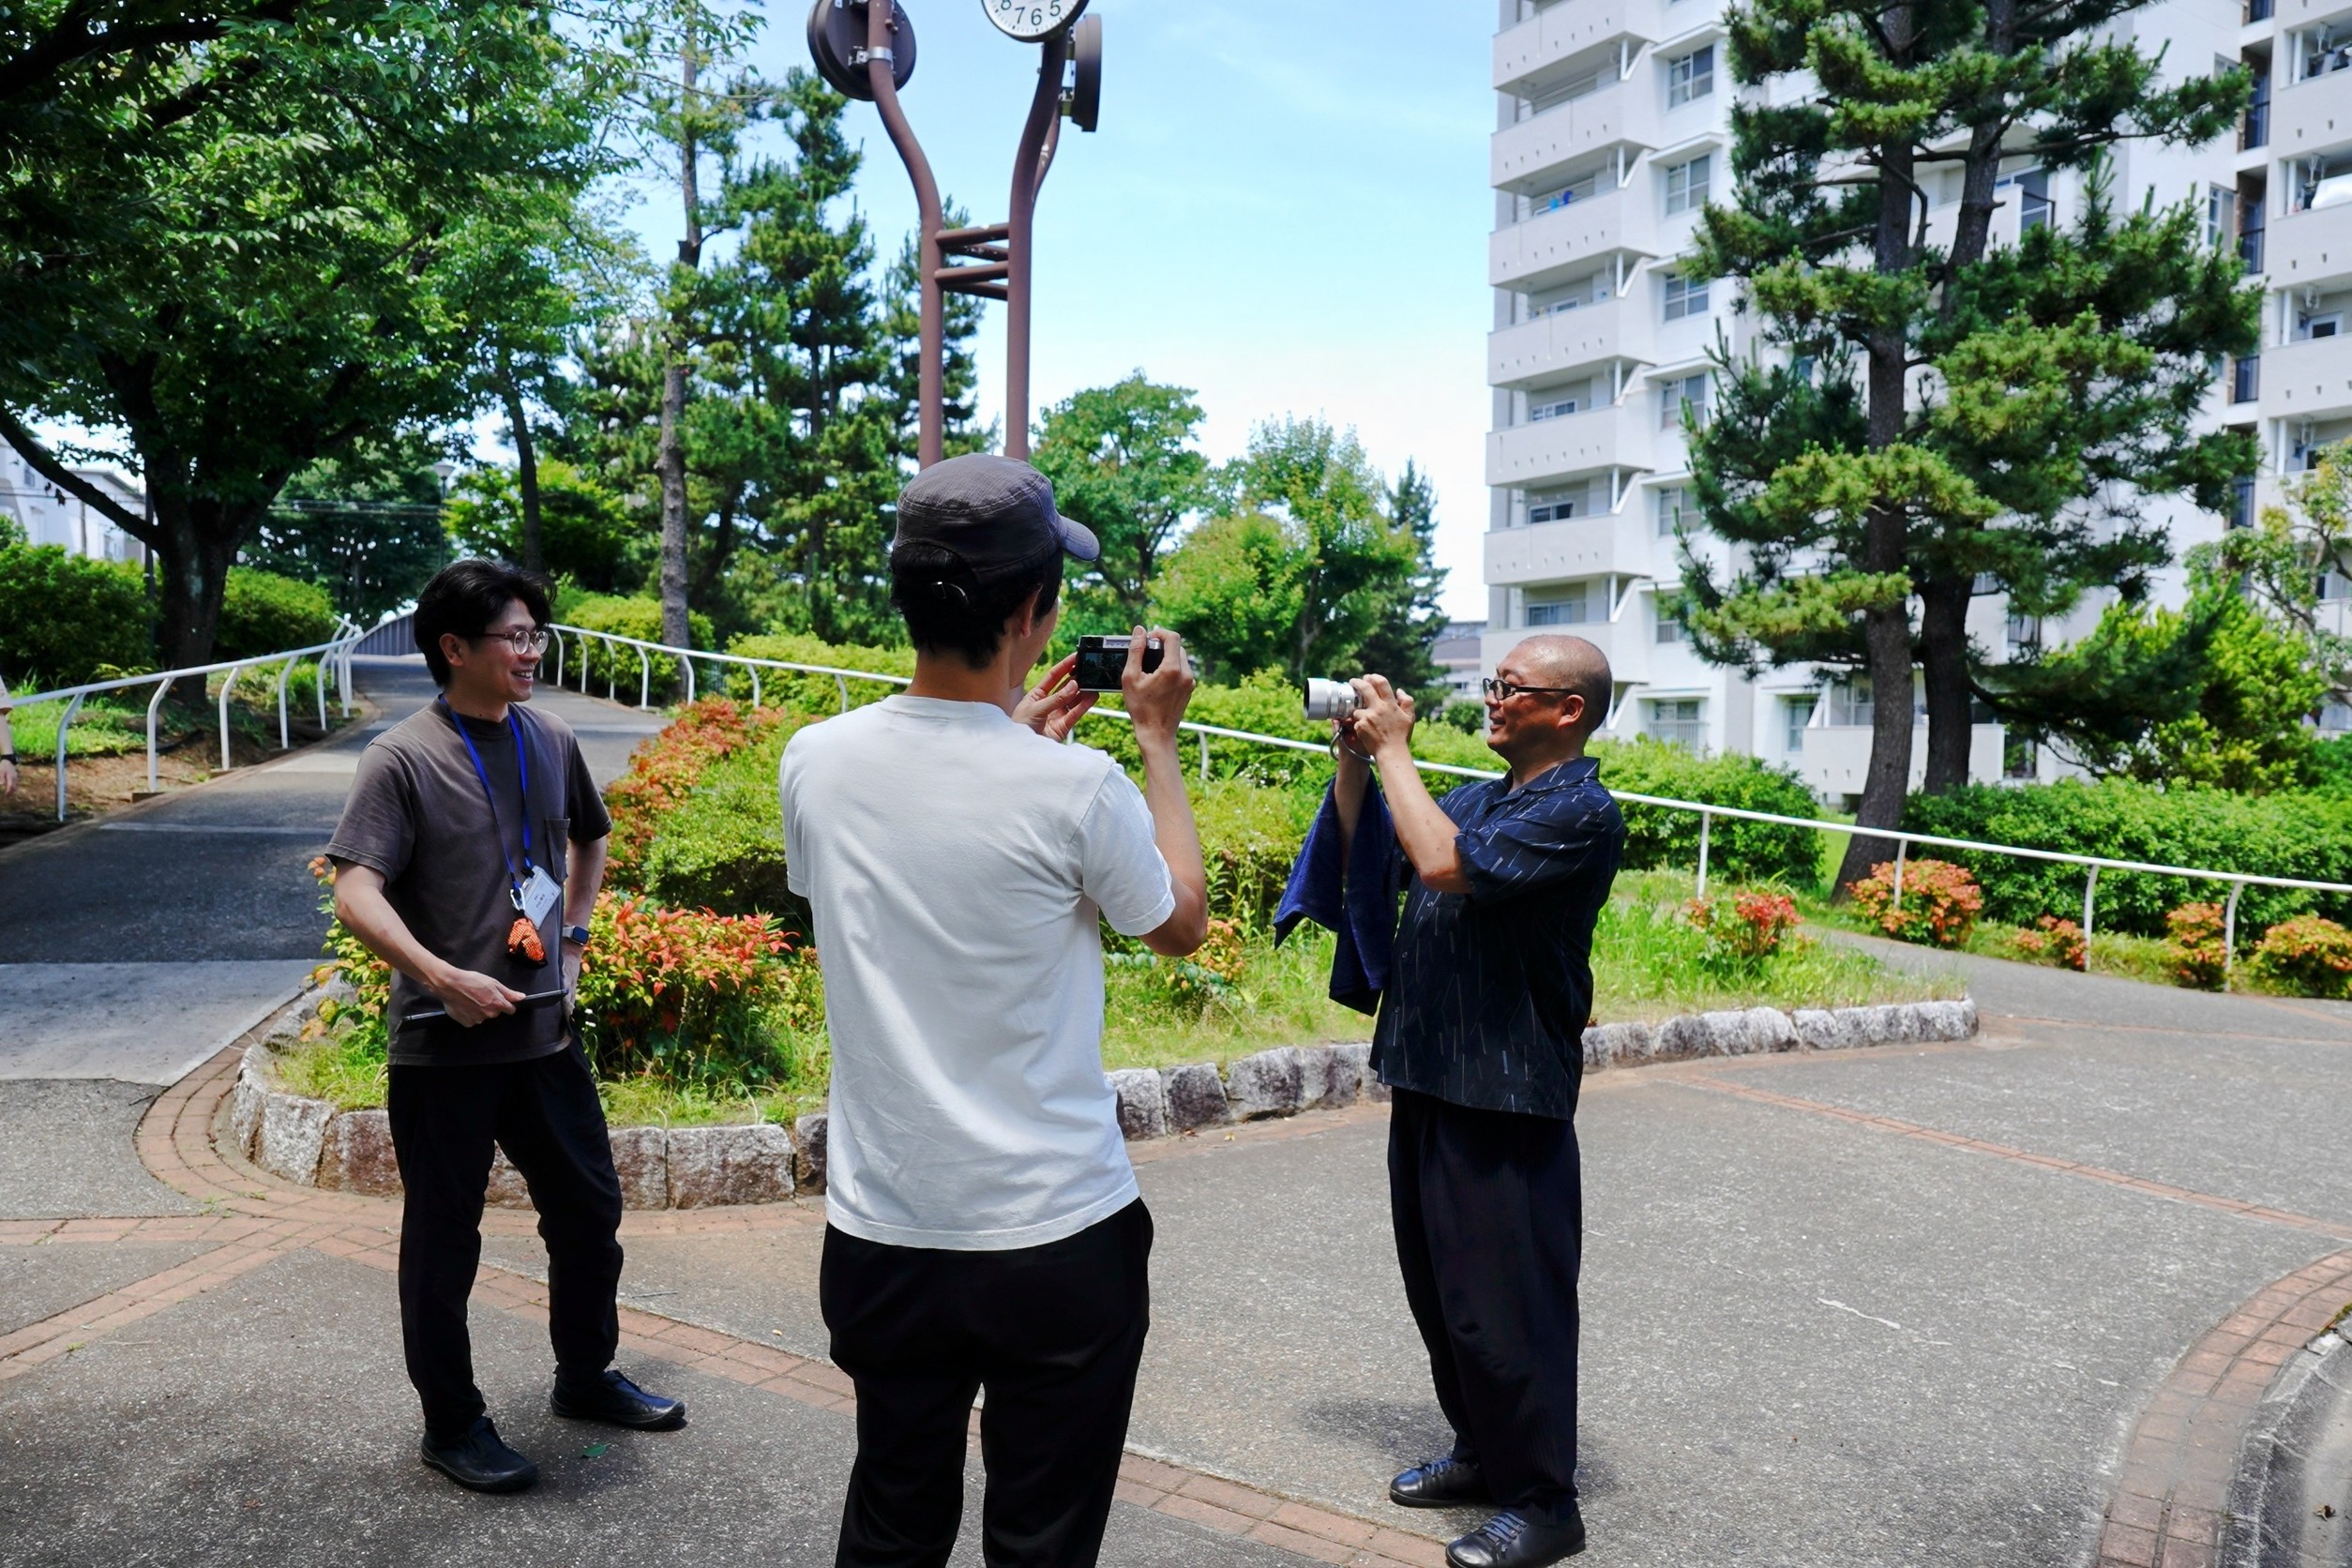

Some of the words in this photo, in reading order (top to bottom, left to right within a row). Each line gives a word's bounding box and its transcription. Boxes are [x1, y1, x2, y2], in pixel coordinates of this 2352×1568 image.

[1015, 6, 1025, 24] 7
[1031, 8, 1042, 26] 6
[1049, 0, 1061, 17] 5
